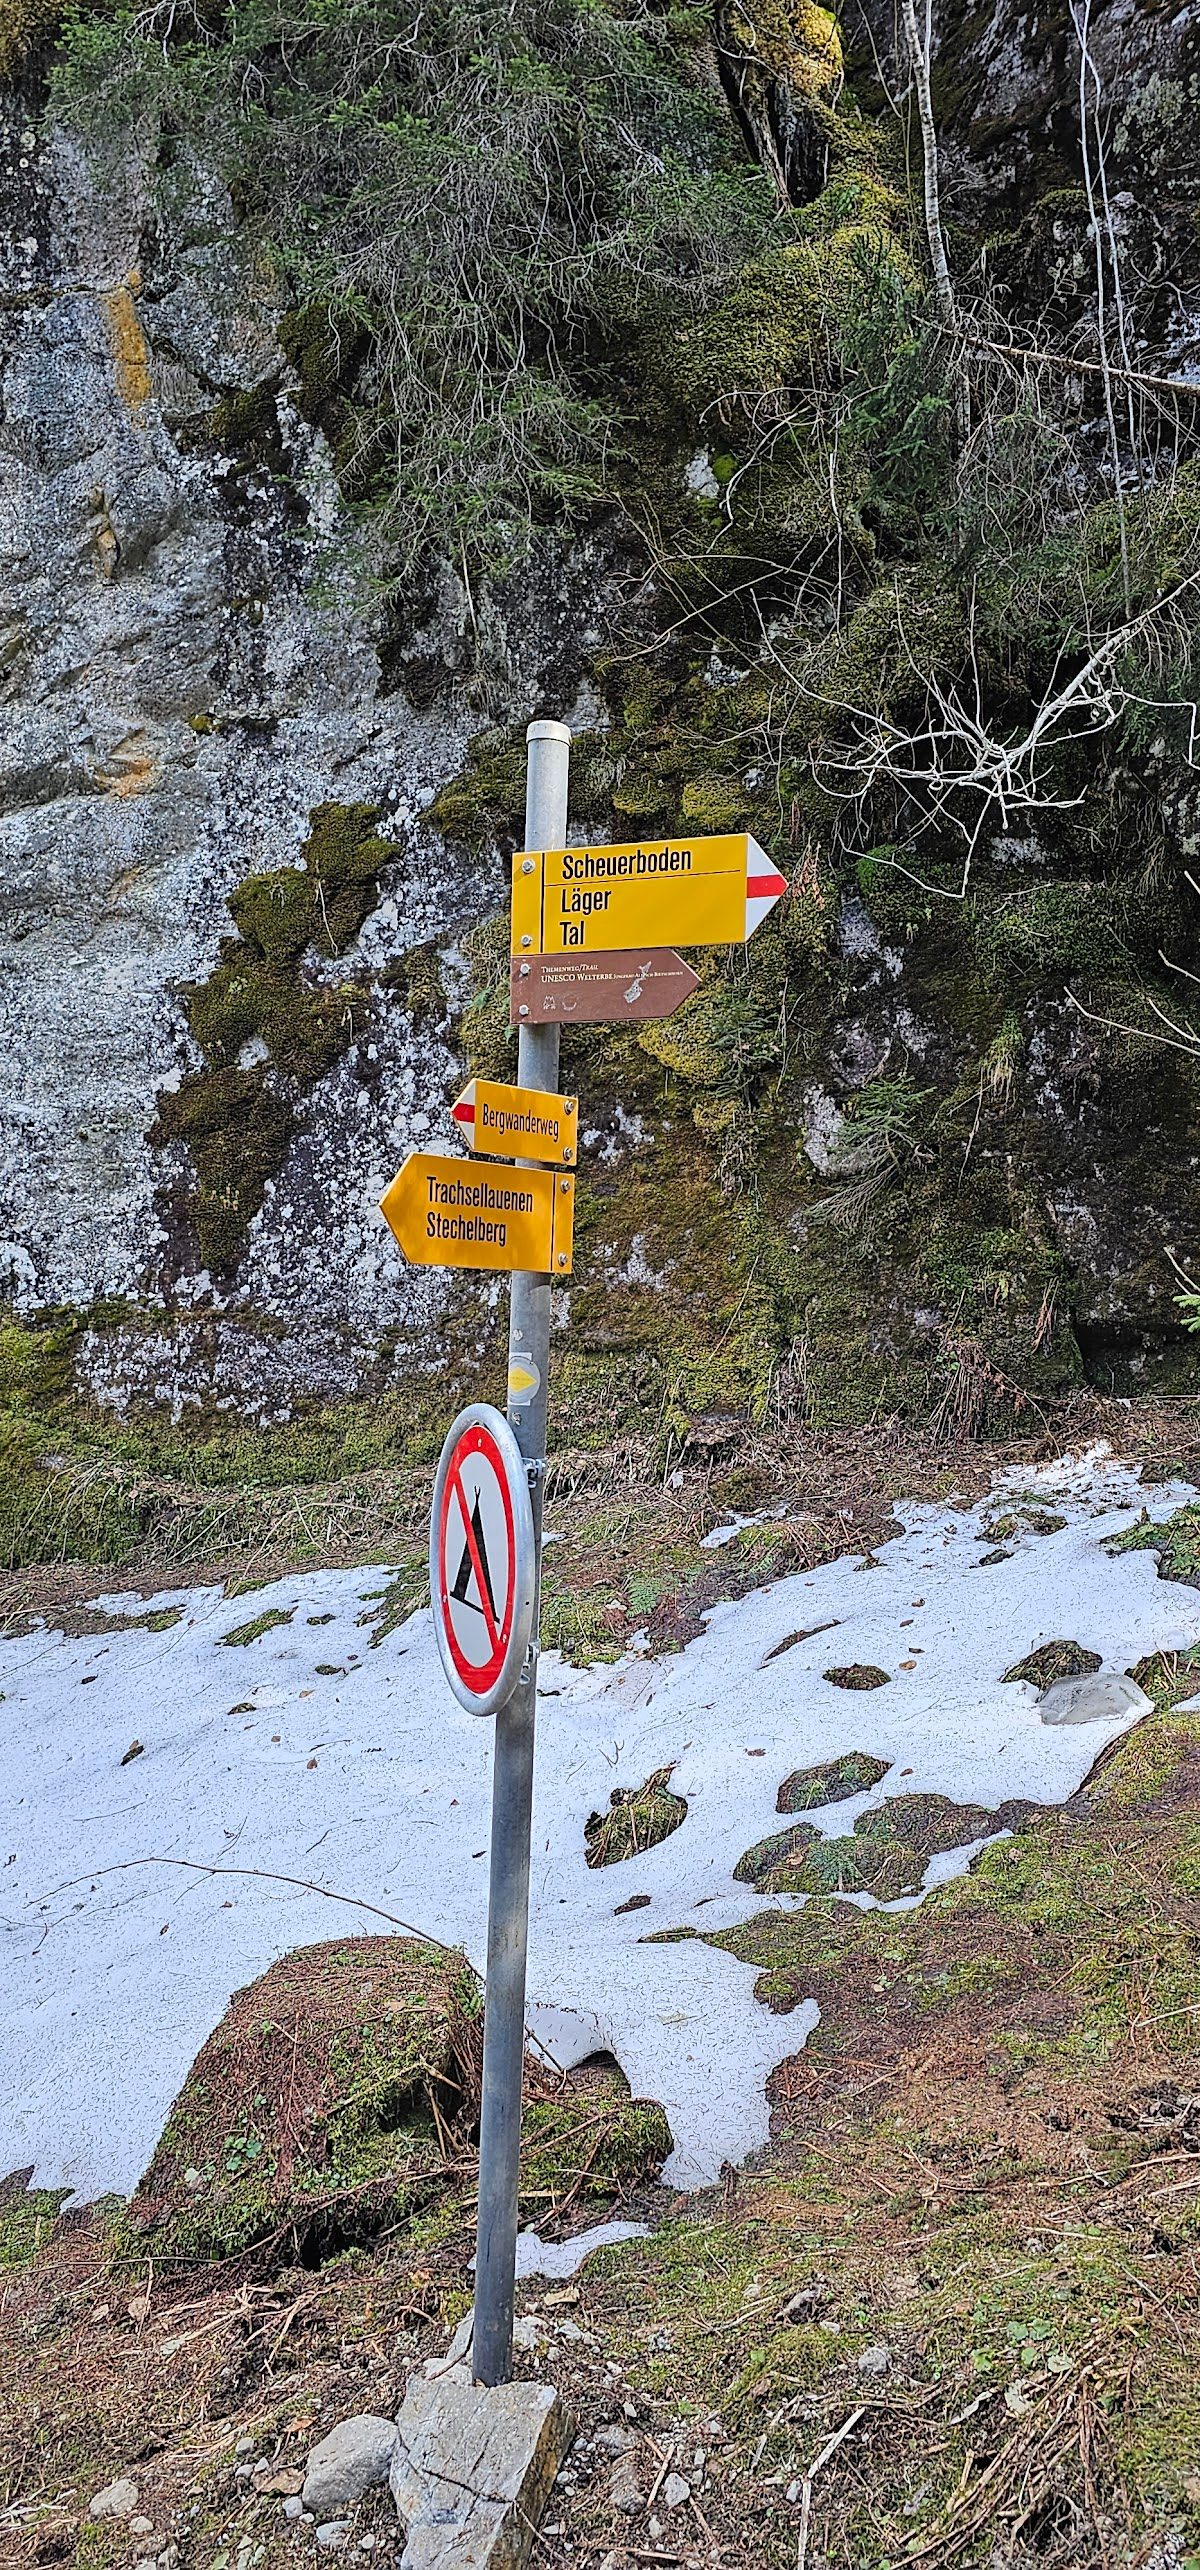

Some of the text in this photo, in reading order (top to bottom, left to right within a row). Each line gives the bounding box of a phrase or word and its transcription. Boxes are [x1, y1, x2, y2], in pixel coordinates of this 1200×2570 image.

[562, 847, 691, 880] Scheuerboden
[561, 887, 612, 915] Läger
[560, 921, 585, 946] Tal
[541, 974, 575, 983] UNESCO
[482, 1103, 559, 1143] Bergwanderweg
[427, 1176, 533, 1212] Trachsellauenen
[427, 1211, 506, 1248] Stechelberg
